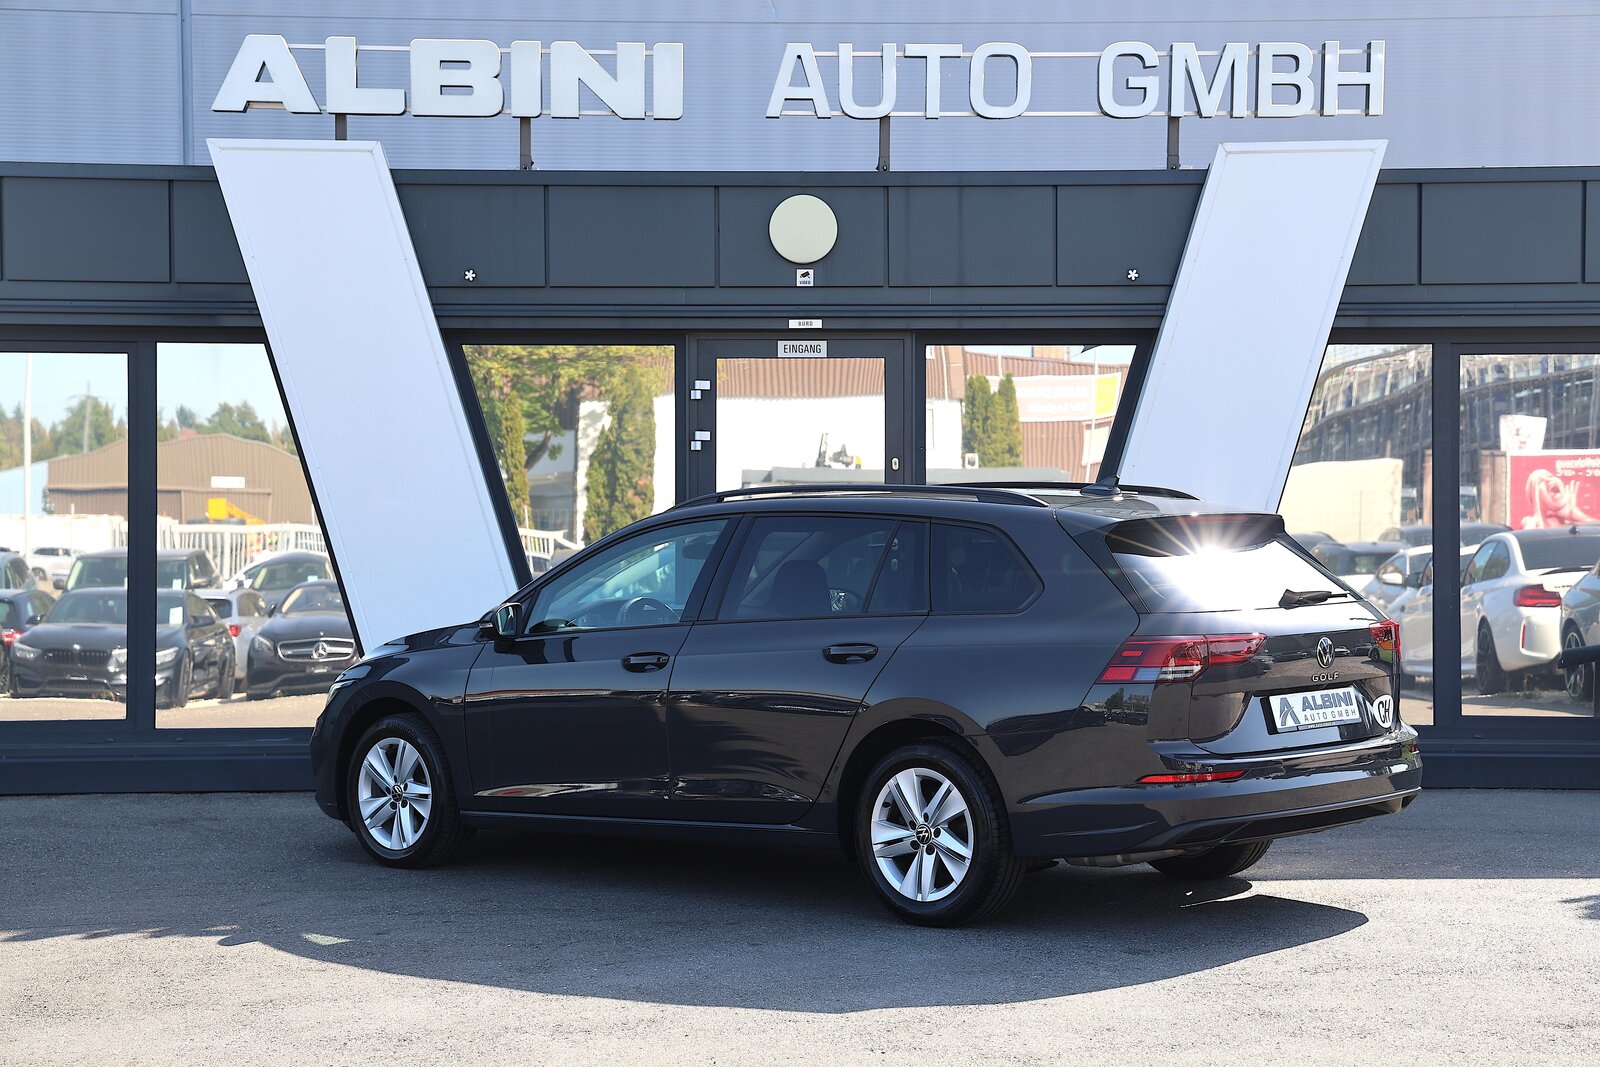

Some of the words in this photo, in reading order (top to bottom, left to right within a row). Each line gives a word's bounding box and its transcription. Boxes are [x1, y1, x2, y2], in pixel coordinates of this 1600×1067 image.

[211, 33, 684, 120] ALBINI
[765, 41, 1033, 119] AUTO
[1098, 40, 1386, 119] GMBH
[783, 344, 822, 354] EINGANG
[1311, 671, 1340, 682] GOLF
[1301, 691, 1354, 712] ALBINI
[1304, 711, 1328, 722] AUTO
[1331, 707, 1357, 719] GMBH
[1377, 699, 1391, 724] CH
